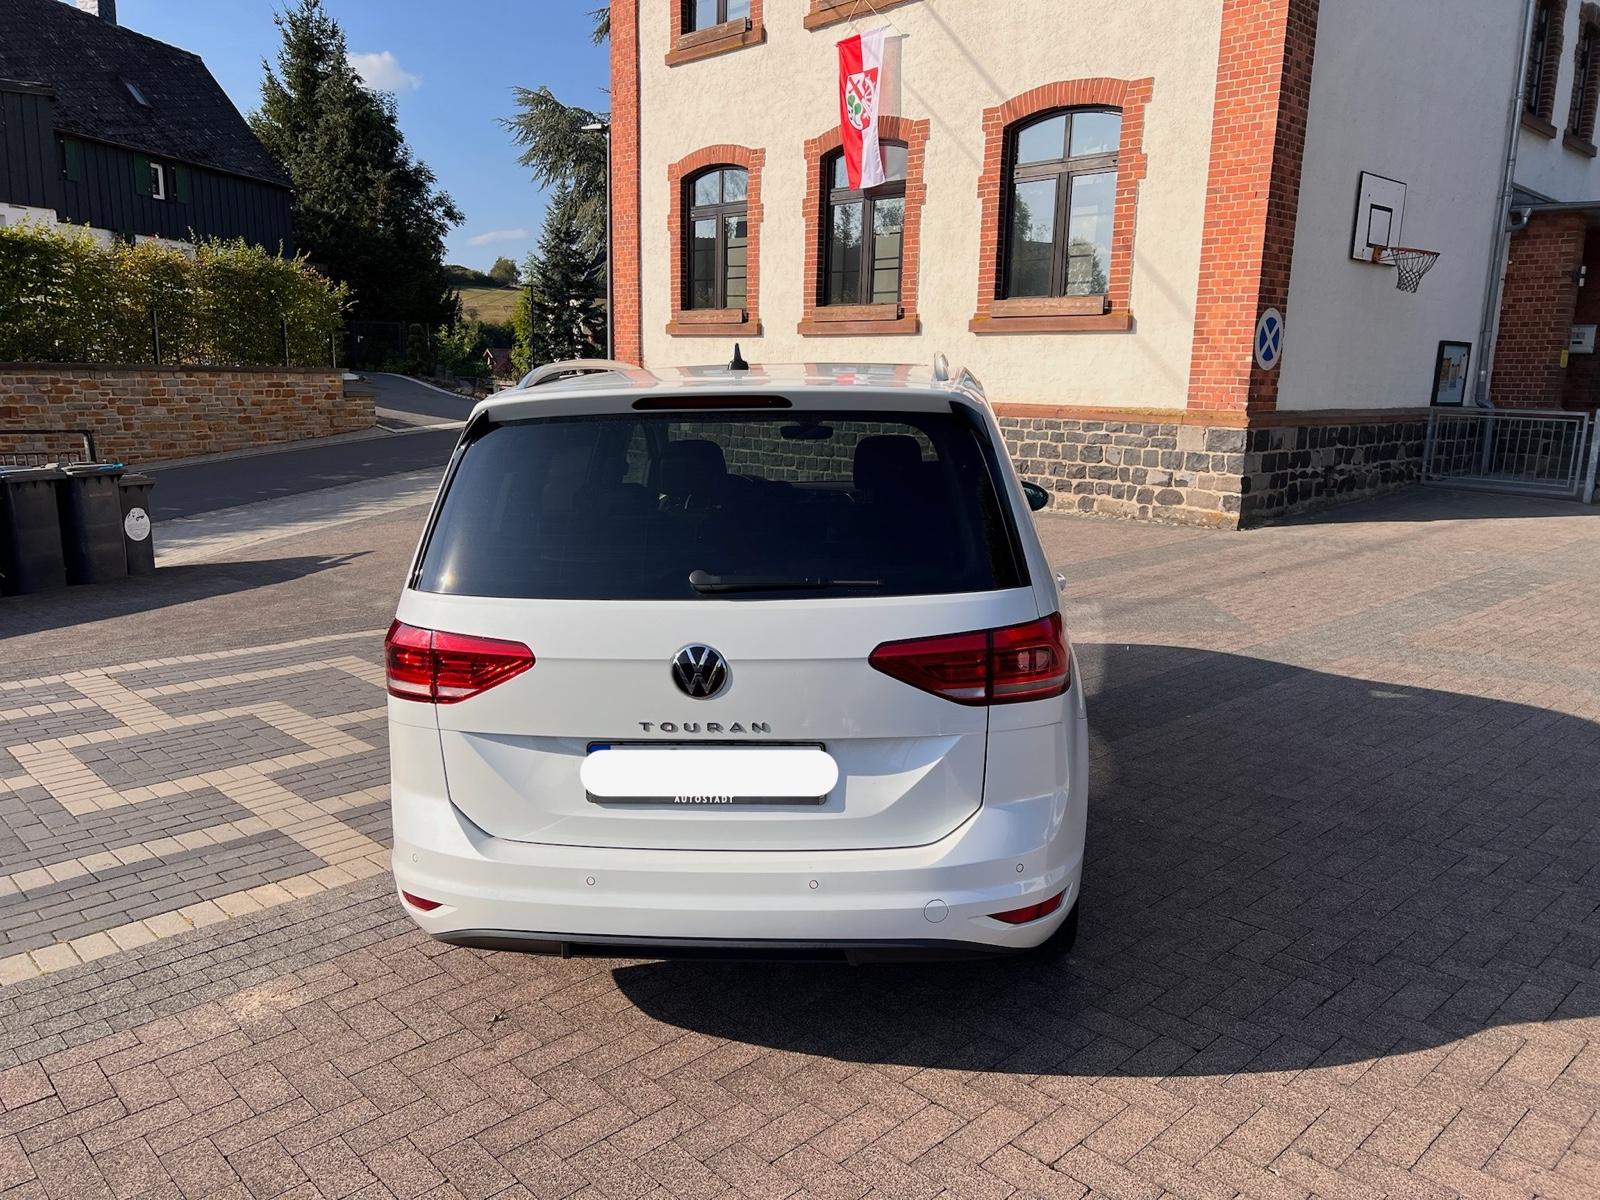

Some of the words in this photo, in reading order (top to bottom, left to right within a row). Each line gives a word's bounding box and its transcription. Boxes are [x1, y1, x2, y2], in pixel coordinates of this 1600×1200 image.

[672, 644, 727, 698] VW
[638, 721, 771, 734] TOURAN
[673, 795, 734, 804] AUTOSTADT
